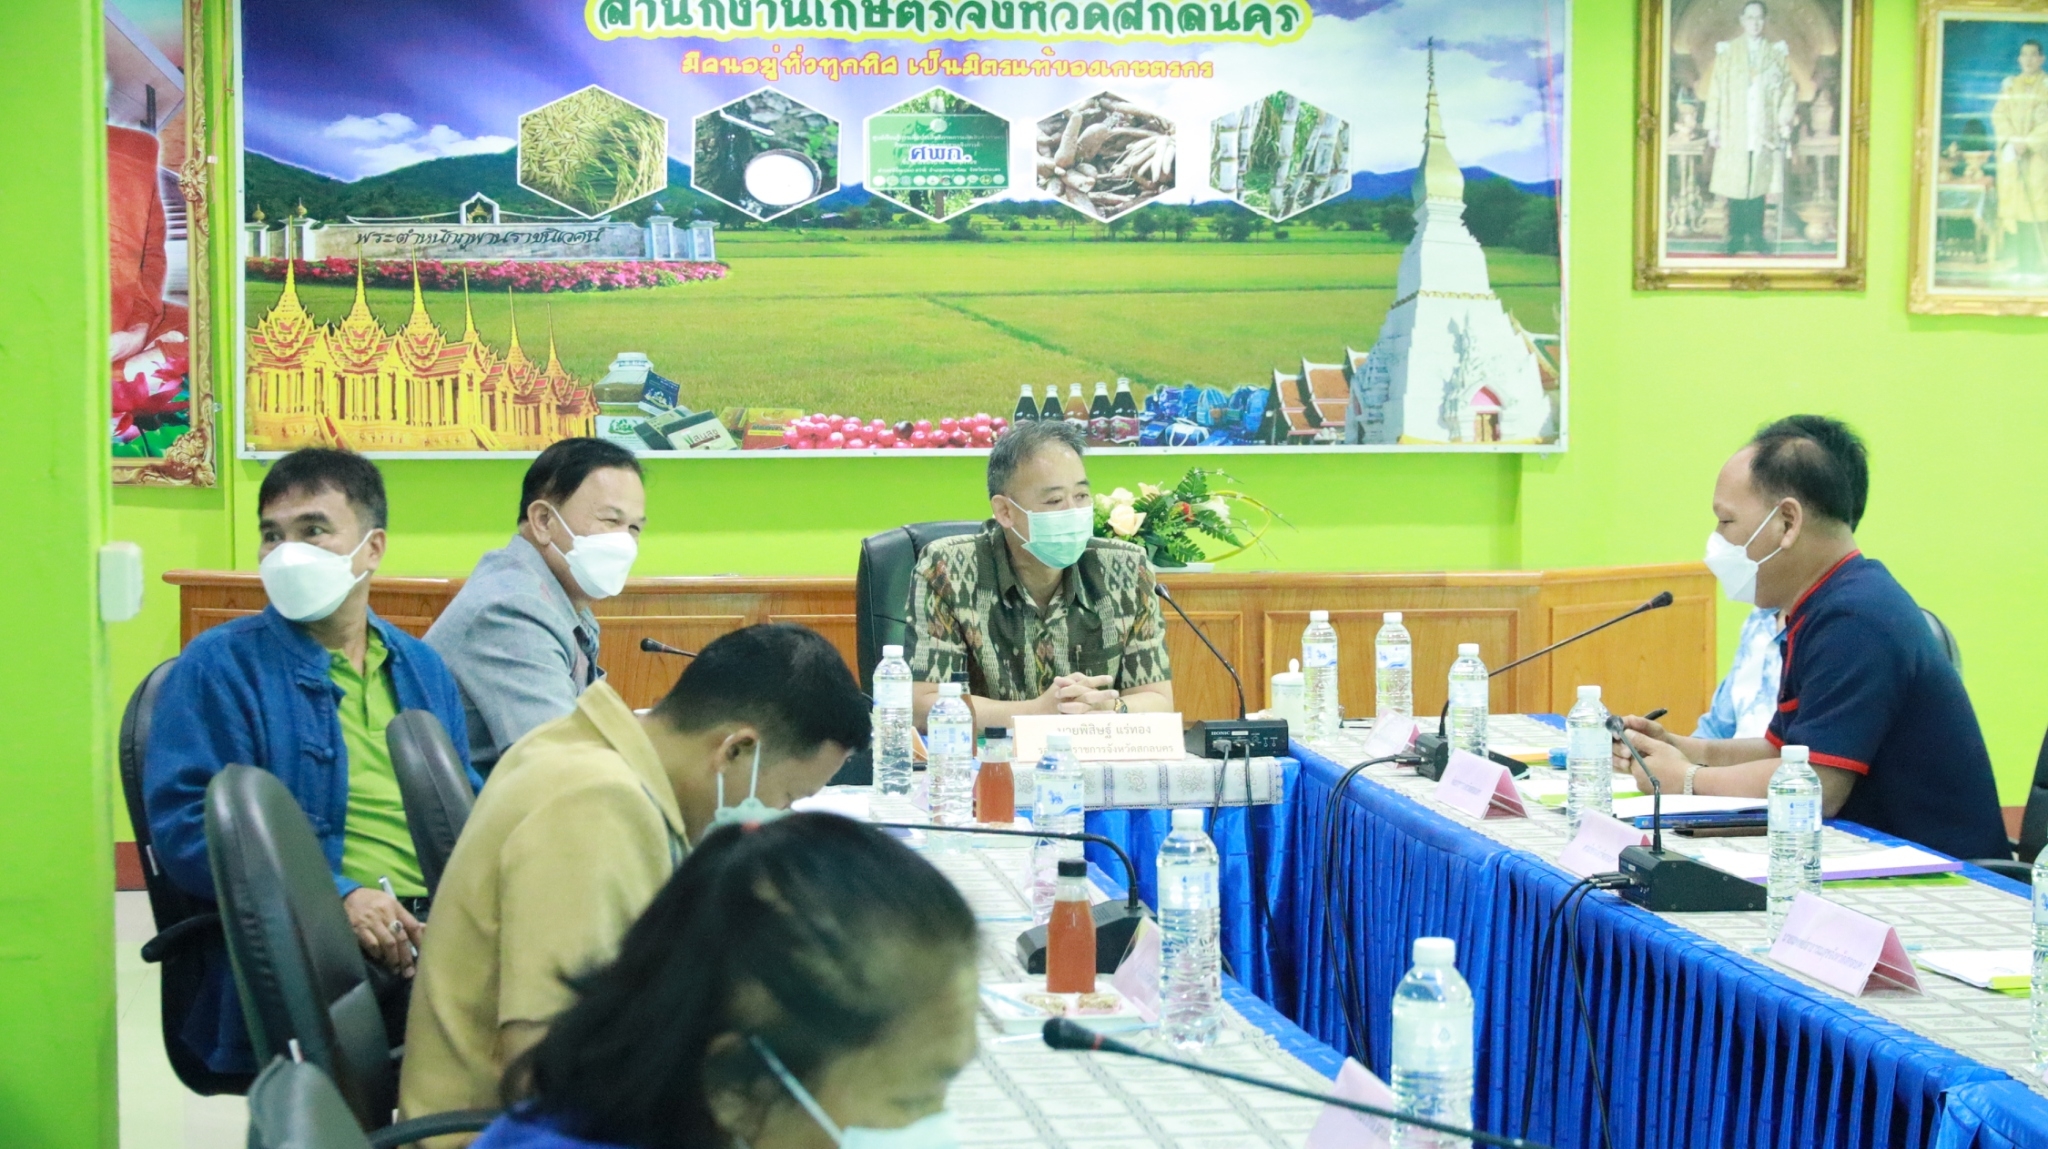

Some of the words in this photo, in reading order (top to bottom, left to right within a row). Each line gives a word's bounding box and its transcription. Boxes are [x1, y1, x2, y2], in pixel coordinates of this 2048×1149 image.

[907, 46, 1214, 78] เป็นมิตรแท้ของเกษตรกร
[910, 145, 972, 161] ศพก.
[1115, 723, 1152, 735] แร่ทอง
